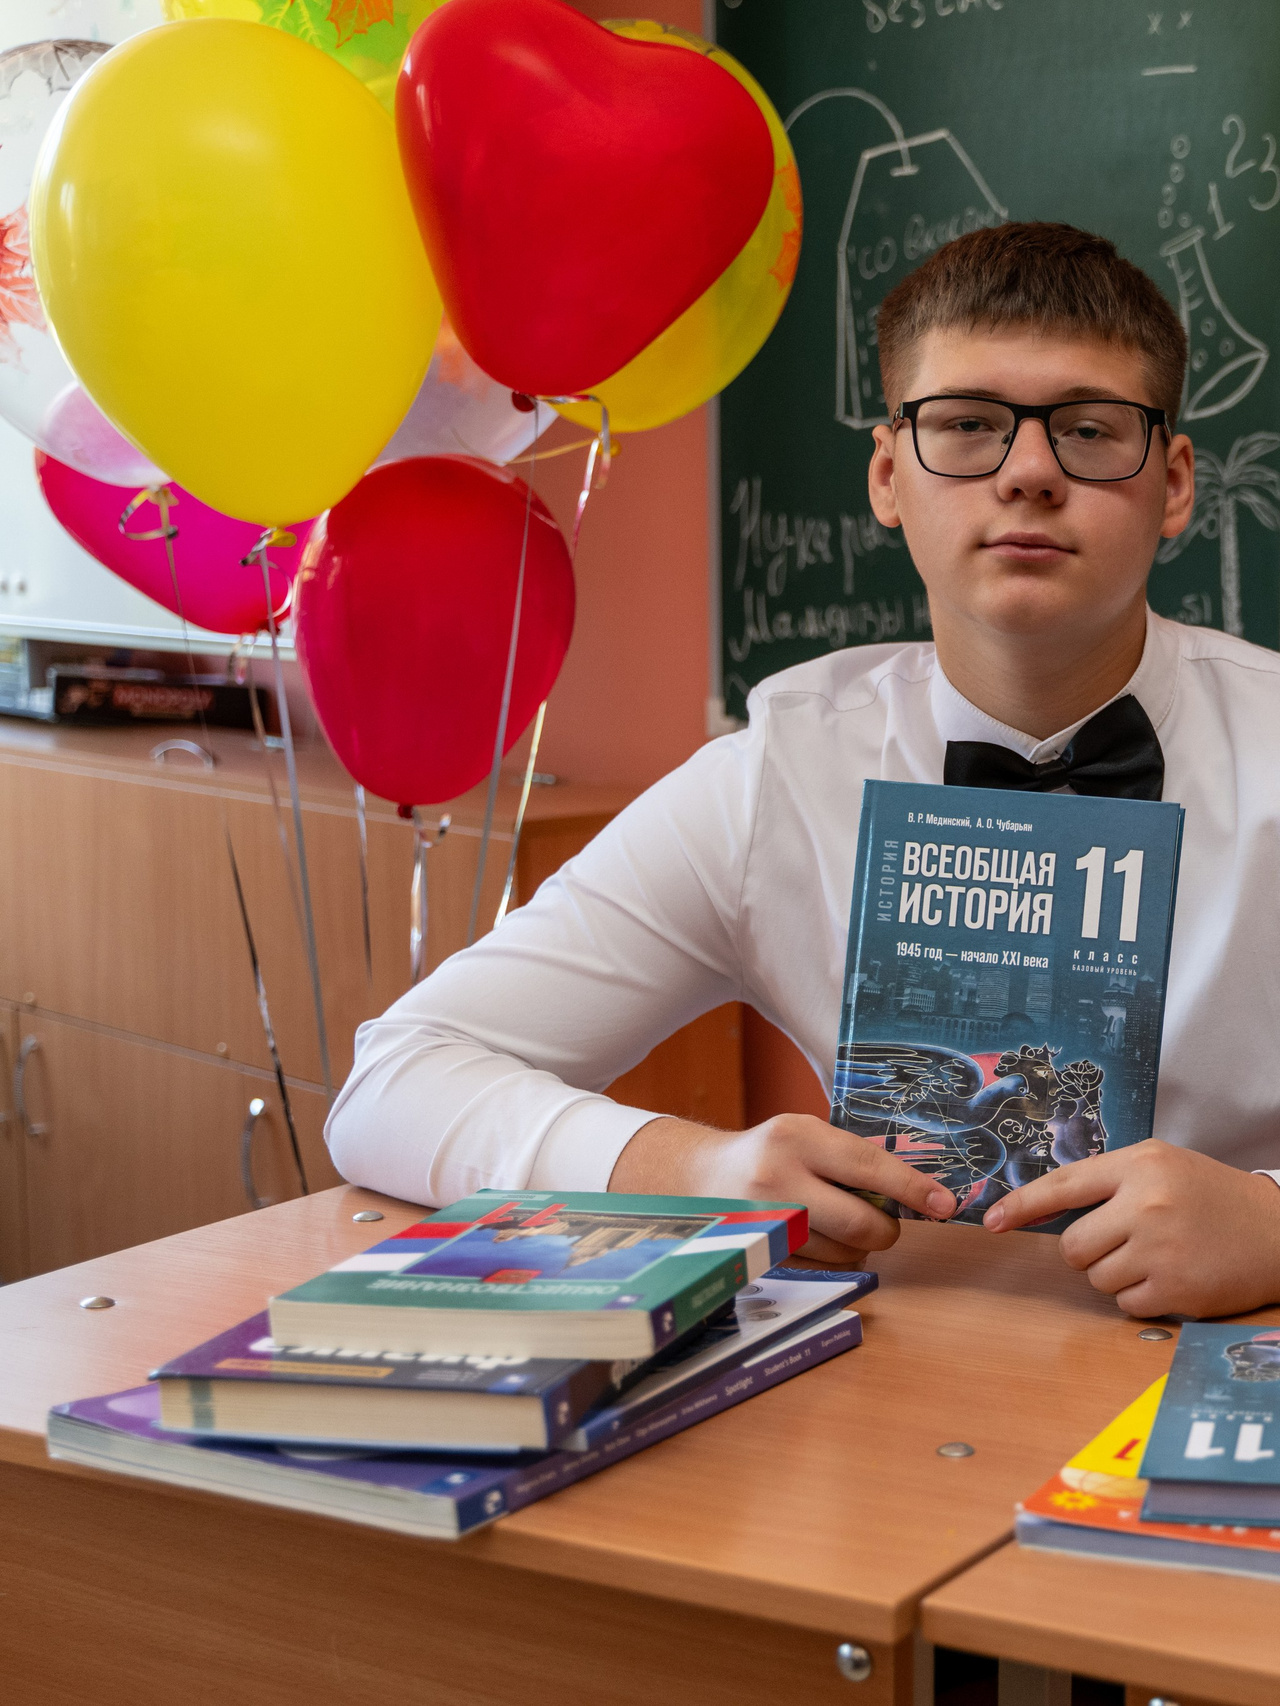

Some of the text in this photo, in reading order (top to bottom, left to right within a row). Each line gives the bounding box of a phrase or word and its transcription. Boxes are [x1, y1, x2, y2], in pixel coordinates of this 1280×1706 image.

[907, 812, 1034, 833] В. Р. Мединский, А. О. Чубарьян
[902, 841, 1058, 889] ВСЕОБЩАЯ
[877, 839, 899, 922] ИСТОРИЯ
[898, 881, 1054, 935] ИСТОРИЯ
[1075, 846, 1144, 943] 11
[896, 942, 922, 958] 1945
[924, 947, 943, 961] год
[960, 950, 999, 965] начало
[1001, 951, 1021, 966] XXI
[1023, 955, 1049, 969] века
[1073, 950, 1139, 965] класс
[1072, 964, 1138, 977] БАЗОВЫЙ УРОВЕНЬ
[471, 1201, 568, 1227] 11
[366, 1277, 621, 1296] ОБЩЕСТВОЗНАНИЕ
[1184, 1420, 1276, 1463] 11
